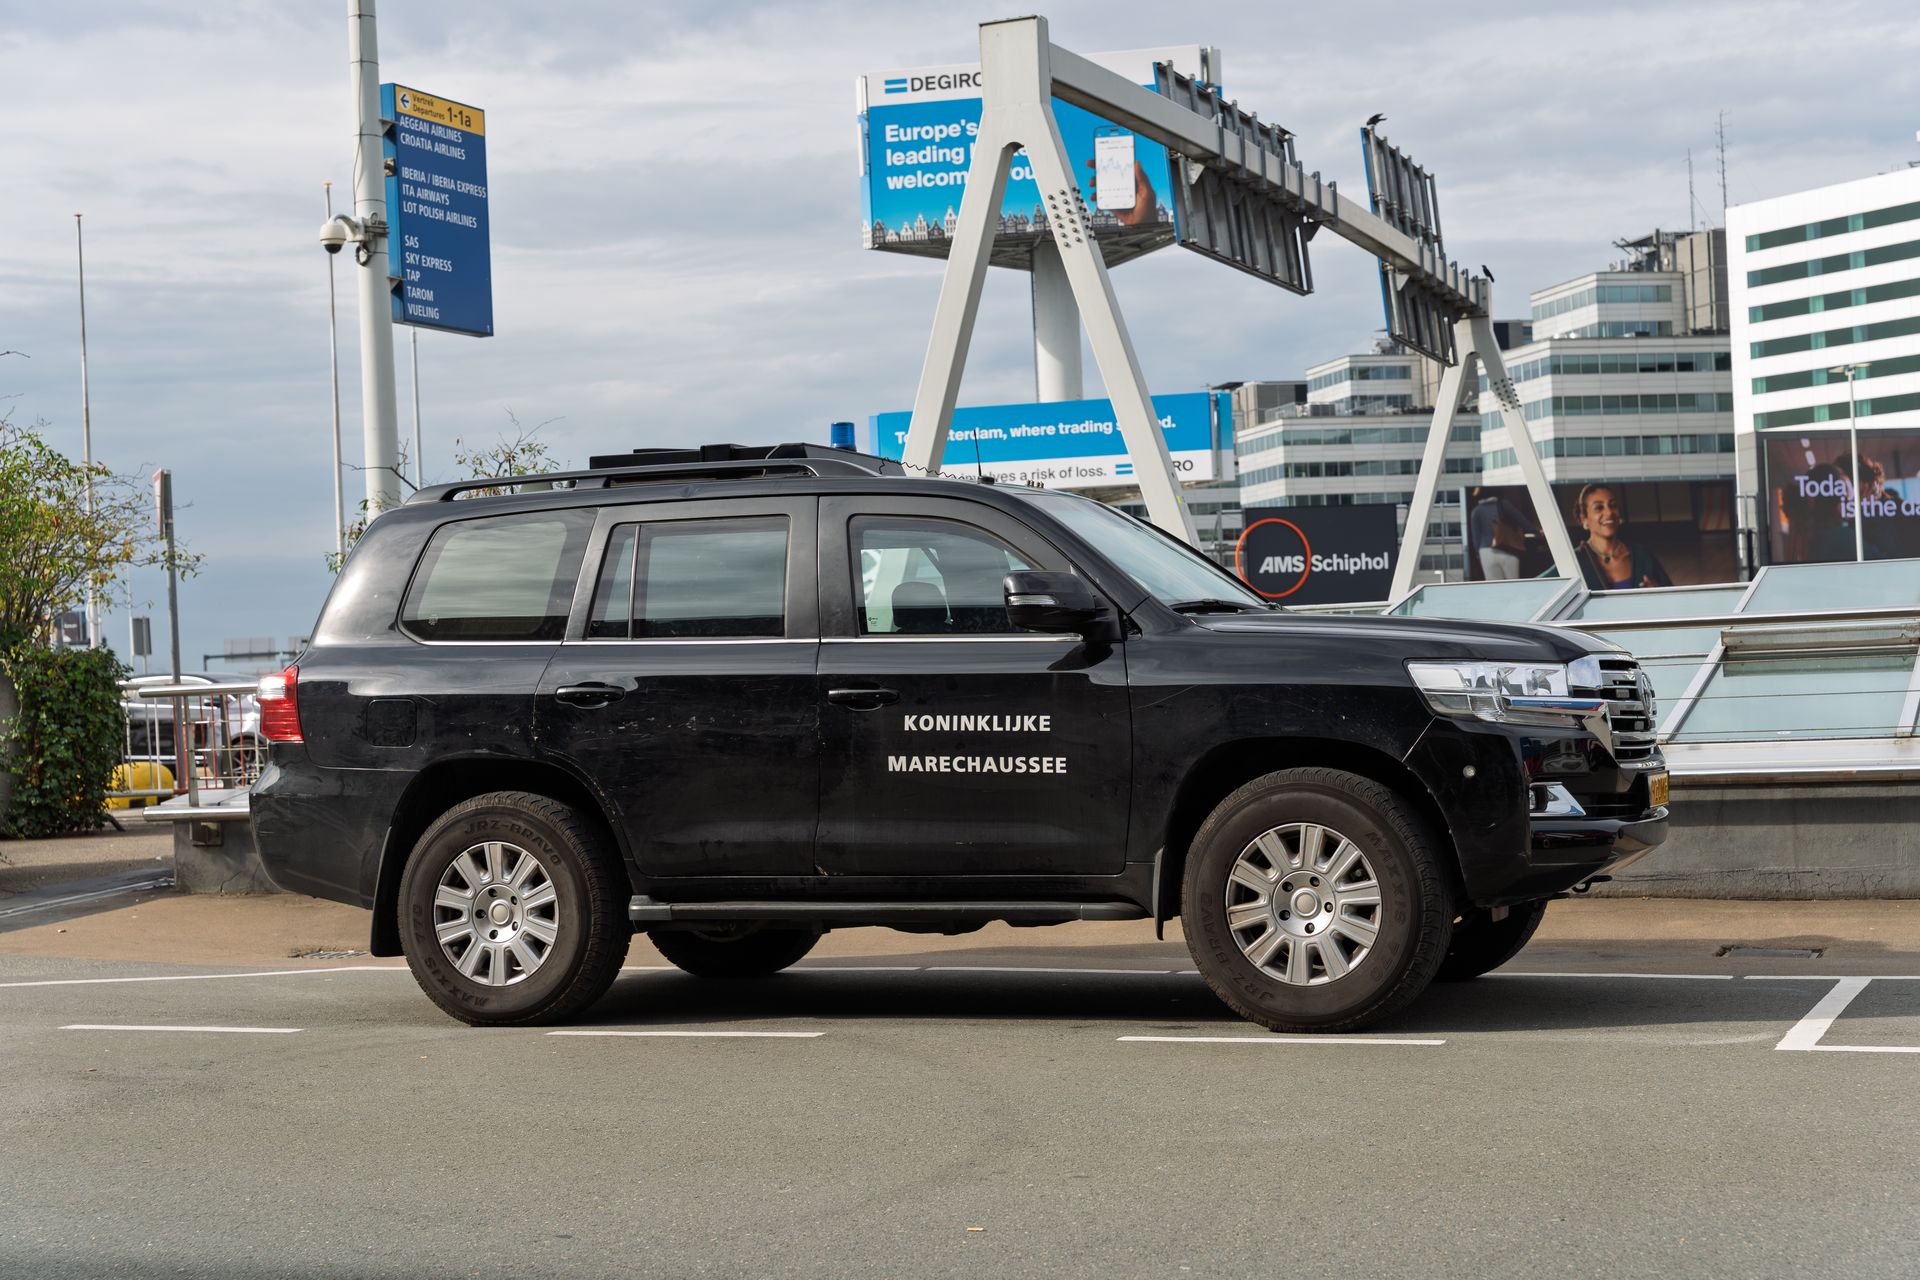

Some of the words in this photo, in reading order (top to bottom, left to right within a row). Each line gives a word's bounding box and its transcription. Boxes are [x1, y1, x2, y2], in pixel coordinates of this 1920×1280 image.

[413, 94, 433, 105] Vertrek
[413, 105, 445, 119] Departures
[448, 107, 471, 127] 1-1a
[400, 116, 429, 133] AEGEAN
[431, 125, 462, 142] AIRLINES
[885, 119, 978, 142] Europe's
[401, 133, 432, 151] CROATIA
[434, 143, 465, 159] AIRLINES
[886, 145, 964, 166] leading
[402, 167, 425, 182] IBERIA
[432, 175, 455, 190] IBERIA
[457, 181, 486, 198] EXPRESS
[887, 170, 967, 190] welcom
[1011, 166, 1035, 180] ou
[403, 184, 415, 197] ITA
[416, 188, 449, 205] AIRWAYS
[403, 201, 417, 214] LOT
[419, 204, 444, 220] POLISH
[446, 211, 477, 228] AIRLINES
[405, 235, 419, 248] SAS
[406, 252, 419, 265] SKY
[422, 256, 452, 272] EXPRESS
[406, 269, 420, 282] TAP
[407, 286, 433, 301] TAROM
[408, 303, 439, 319] VUELING
[1010, 425, 1055, 437] where
[1058, 420, 1112, 434] trading
[1020, 472, 1027, 480] a
[1032, 468, 1055, 480] risk
[1059, 467, 1071, 478] of
[1076, 466, 1106, 477] loss.
[1795, 474, 1854, 500] Today
[1841, 497, 1855, 518] is
[1861, 495, 1896, 517] the
[1259, 556, 1304, 573] AMS
[1311, 552, 1389, 574] Schiphol
[904, 715, 1050, 732] KONINKLIJKE
[888, 756, 1067, 773] MARECHAUSSEE
